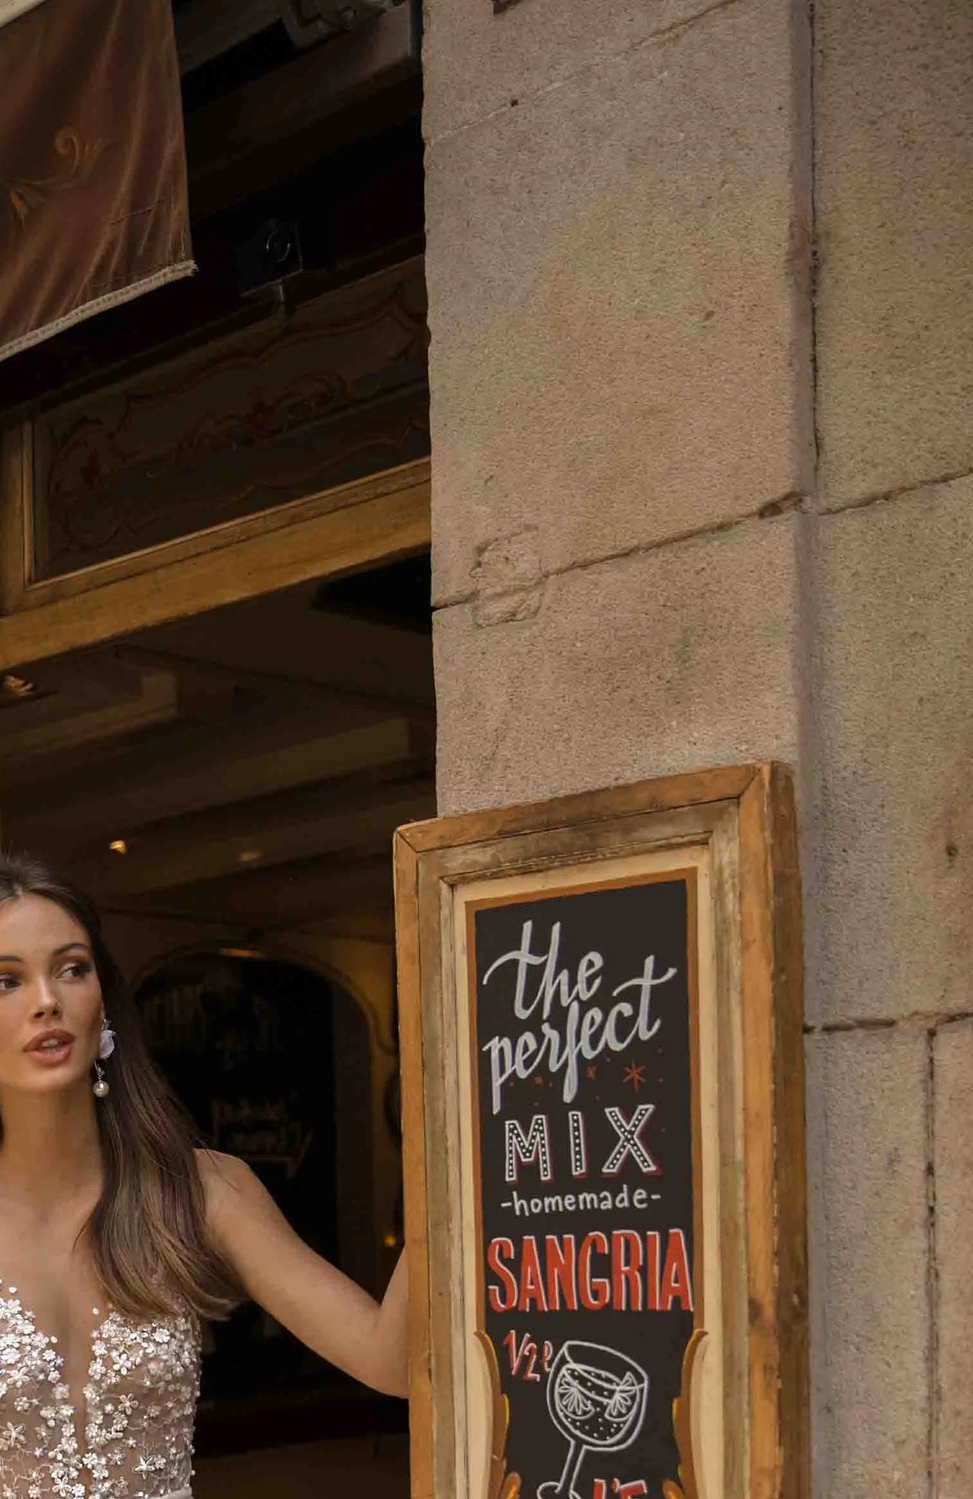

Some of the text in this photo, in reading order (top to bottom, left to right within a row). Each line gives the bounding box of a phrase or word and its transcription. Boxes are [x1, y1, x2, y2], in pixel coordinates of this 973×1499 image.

[482, 920, 603, 1021] the
[482, 954, 678, 1114] perfect
[504, 1104, 659, 1183] MIX
[486, 1228, 694, 1313] SANGRIA
